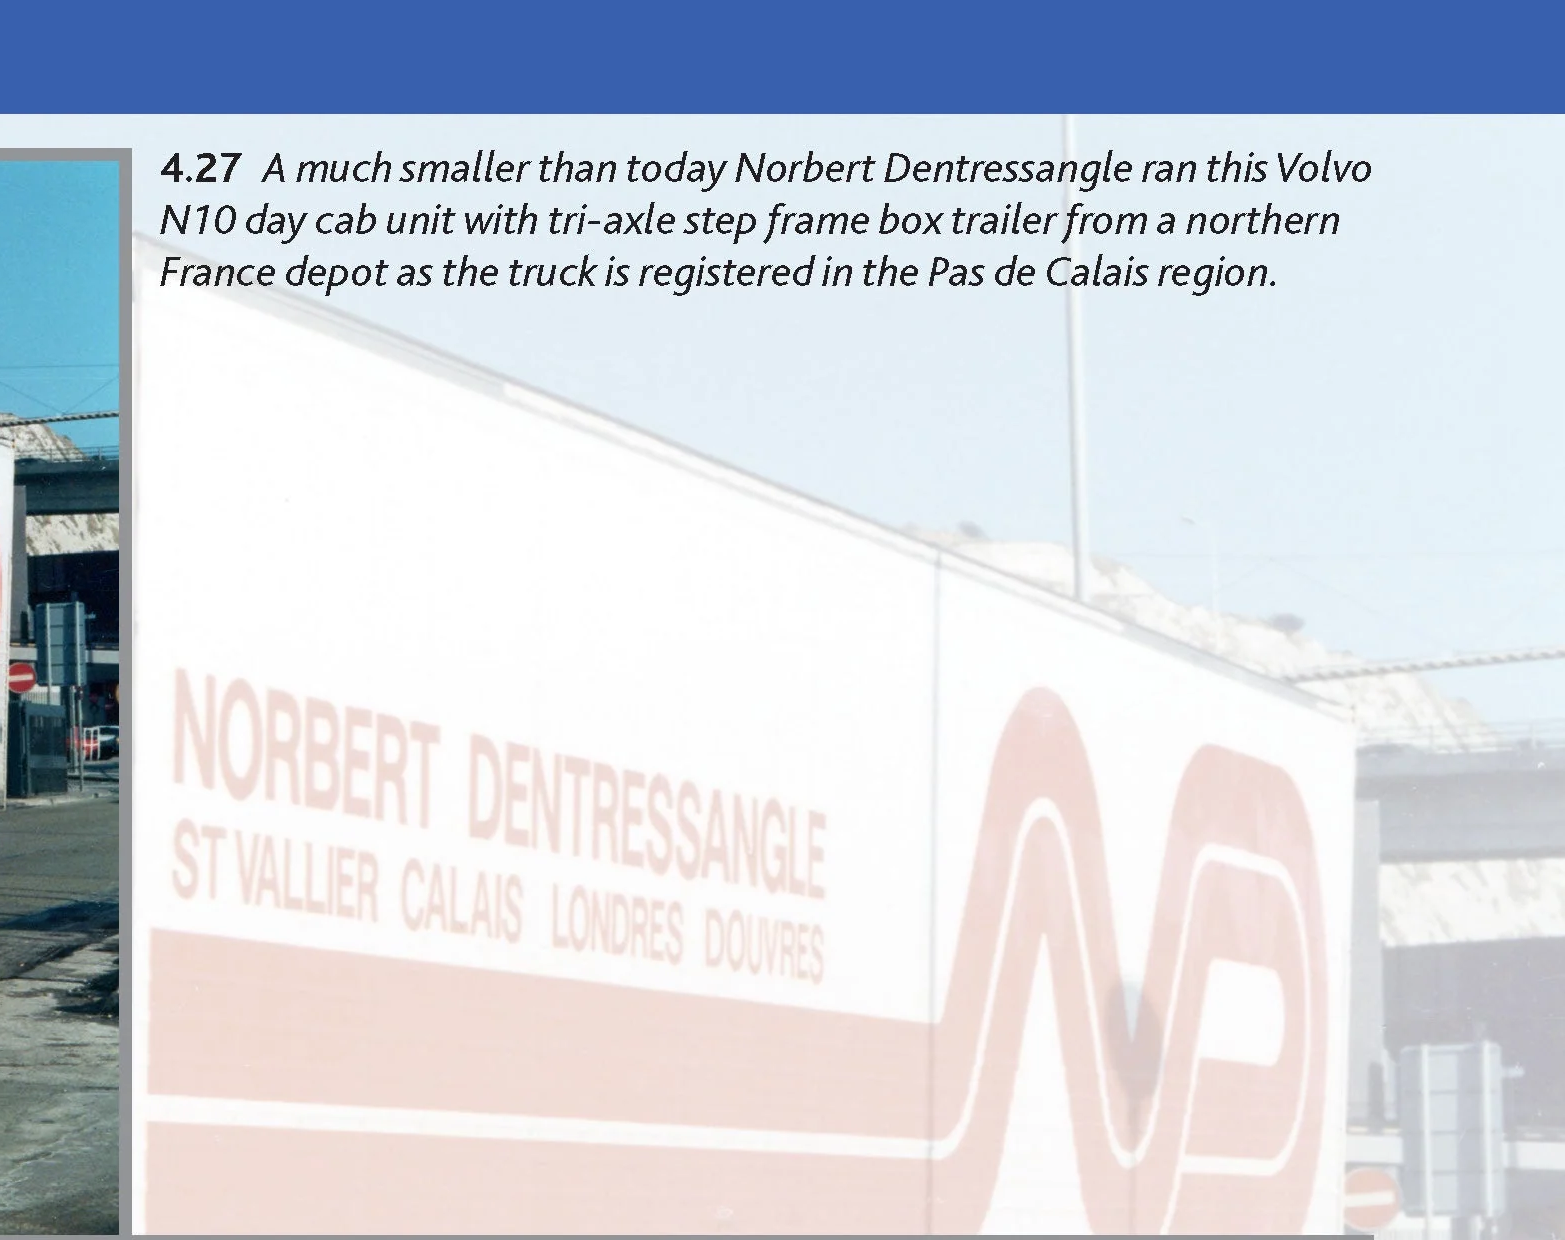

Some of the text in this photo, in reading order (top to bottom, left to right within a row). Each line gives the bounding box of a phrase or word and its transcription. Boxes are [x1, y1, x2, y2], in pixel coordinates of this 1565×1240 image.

[172, 666, 826, 900] NORBERT DENTRESSANGLE
[172, 818, 824, 985] ST VALLIER CALAIS LONDRES DOUVRES
